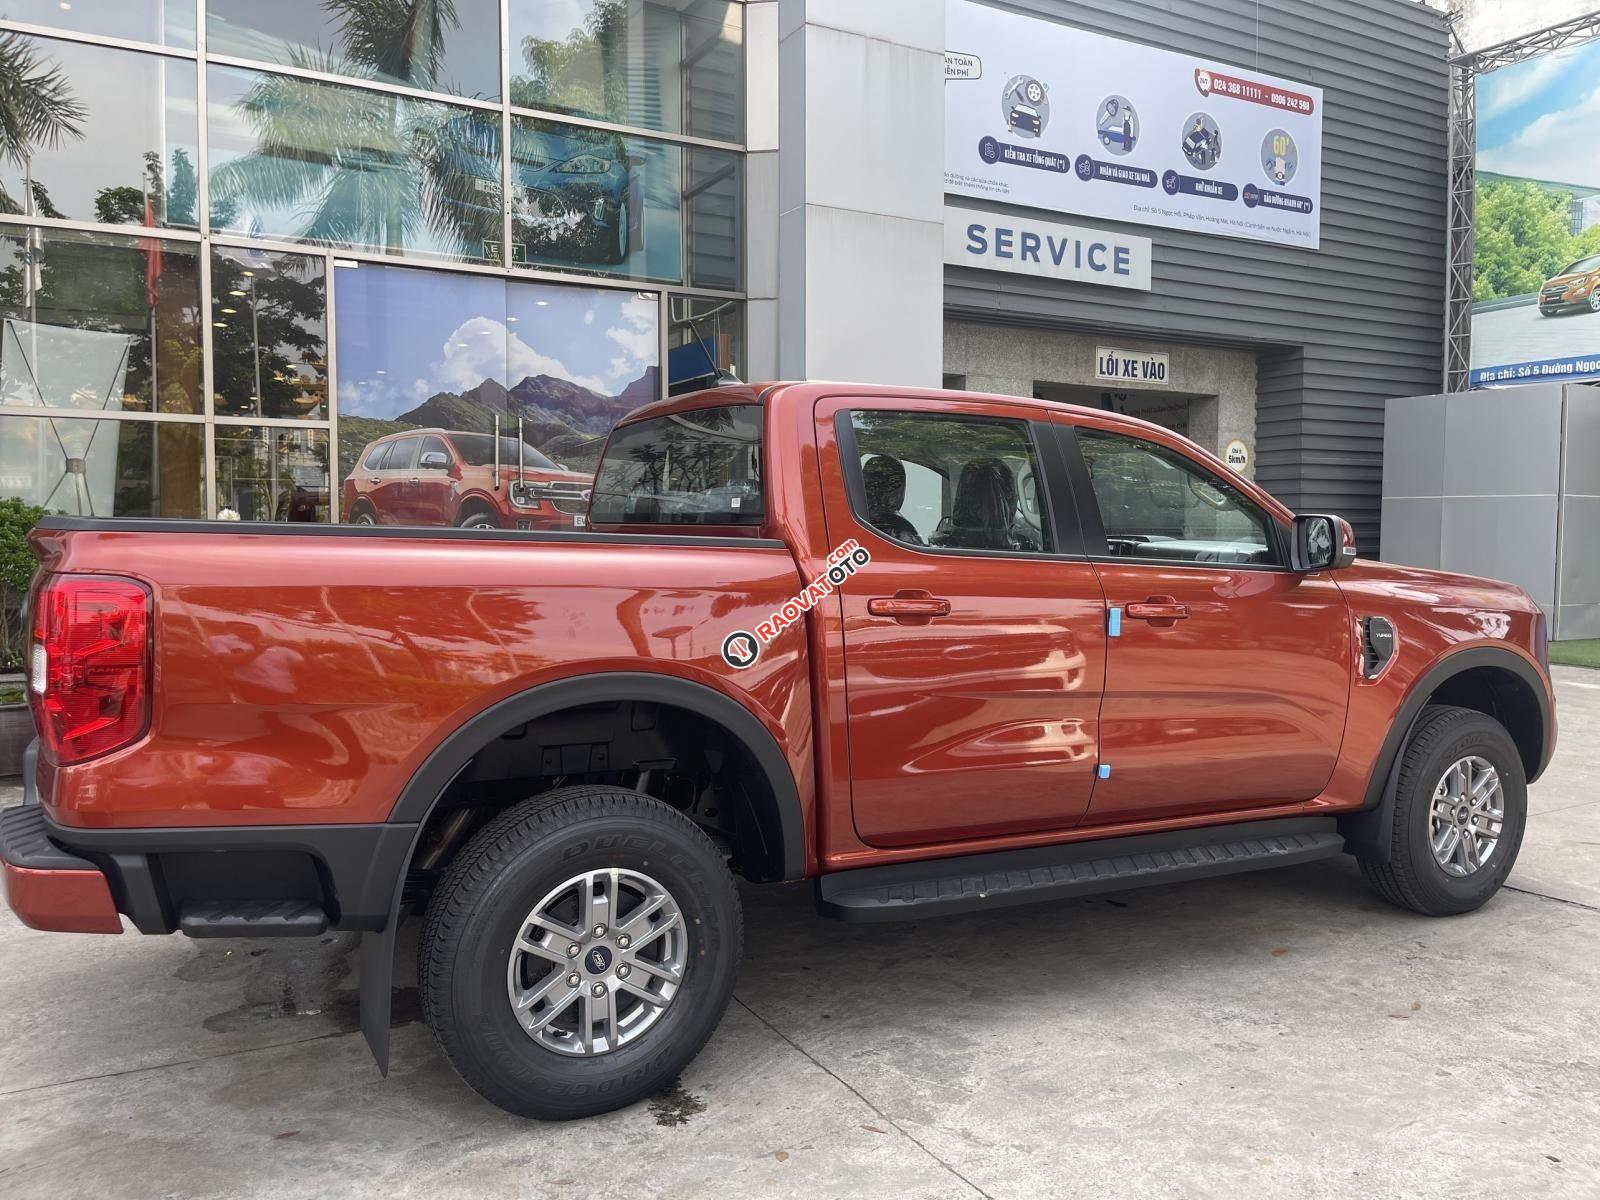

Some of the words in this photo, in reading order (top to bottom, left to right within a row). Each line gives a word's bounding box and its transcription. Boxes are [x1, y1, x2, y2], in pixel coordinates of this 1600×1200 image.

[954, 58, 973, 66] TOÀN
[957, 69, 969, 77] PHÍ
[1213, 79, 1226, 91] 024
[1242, 86, 1261, 99] 11111
[1287, 97, 1298, 108] 242
[1017, 151, 1026, 161] TRA
[1026, 152, 1032, 162] XE
[966, 224, 1130, 275] SERVICE
[1100, 351, 1118, 376] LỐI
[1123, 359, 1138, 378] XE
[1142, 357, 1165, 380] VÀO
[1480, 371, 1495, 382] Địa
[1518, 364, 1531, 377] Số
[1533, 366, 1539, 375] 5
[1542, 363, 1573, 374] Đường
[1575, 361, 1600, 372] Ngọc
[1229, 455, 1245, 463] 5km/h
